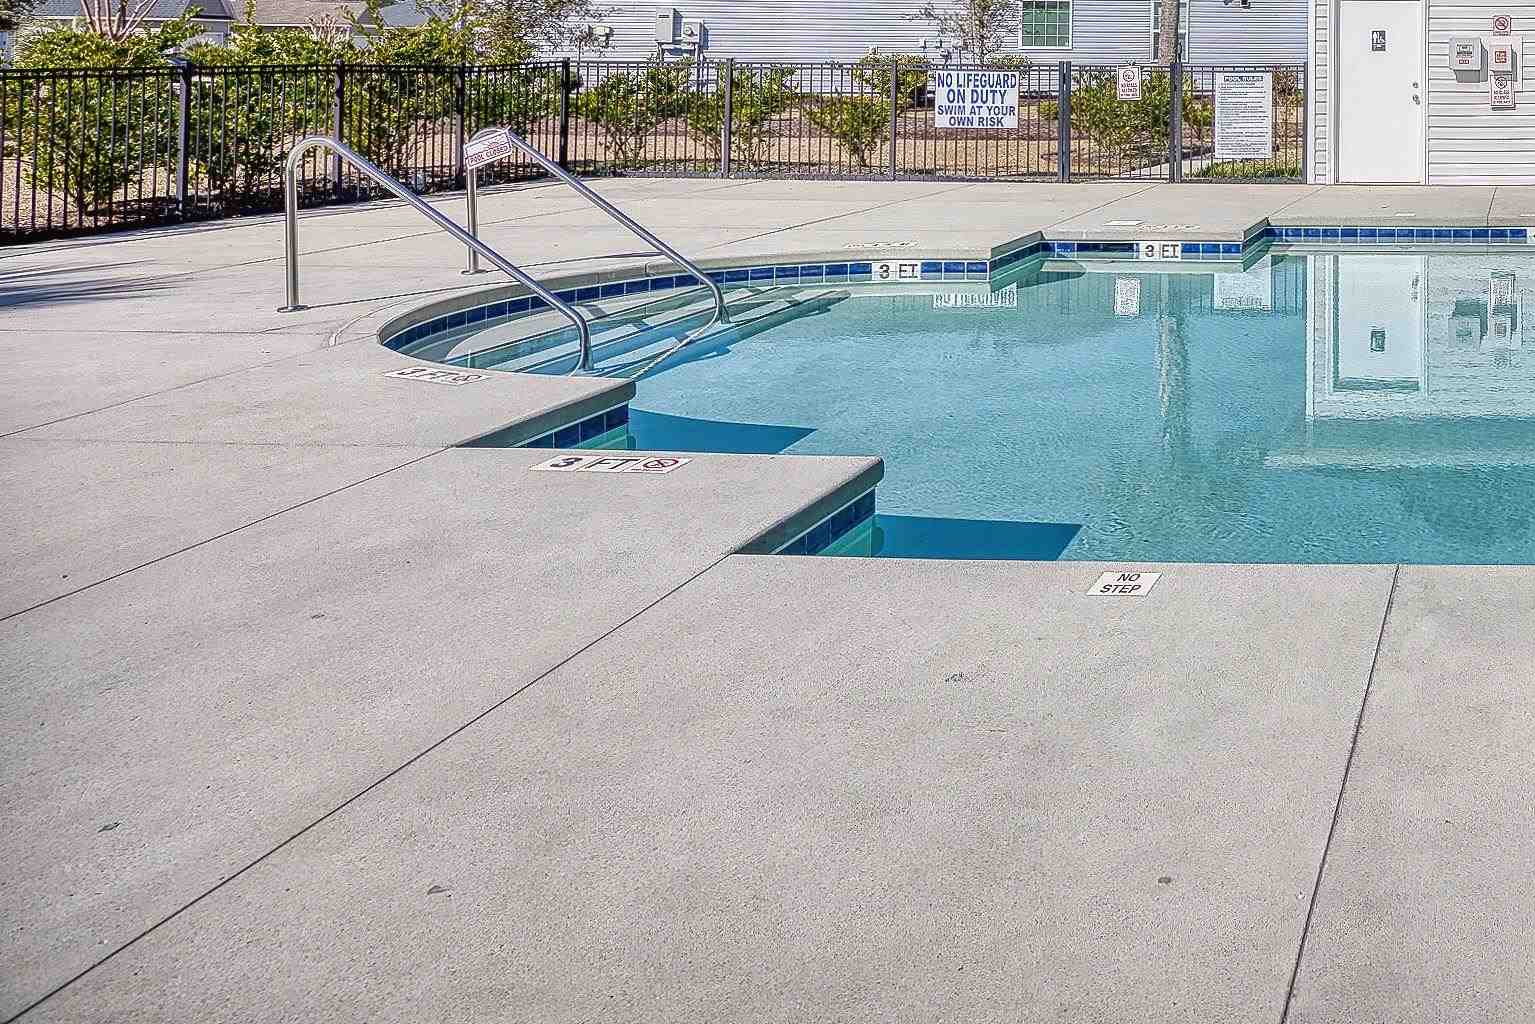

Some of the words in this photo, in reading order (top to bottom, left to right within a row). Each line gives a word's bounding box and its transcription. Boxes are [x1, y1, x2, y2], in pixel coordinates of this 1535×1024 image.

[937, 73, 953, 88] NO
[957, 73, 1017, 88] LIFEGUARD
[947, 89, 966, 104] ON
[971, 89, 1007, 104] DUTY
[938, 105, 966, 116] SWIM
[970, 105, 983, 116] AT
[987, 106, 1016, 116] YOUR
[949, 116, 974, 127] OWN
[978, 116, 1004, 127] RISK
[550, 457, 583, 468] 3
[585, 458, 640, 469] FT
[1117, 573, 1141, 582] NO
[1100, 584, 1142, 593] STEP
